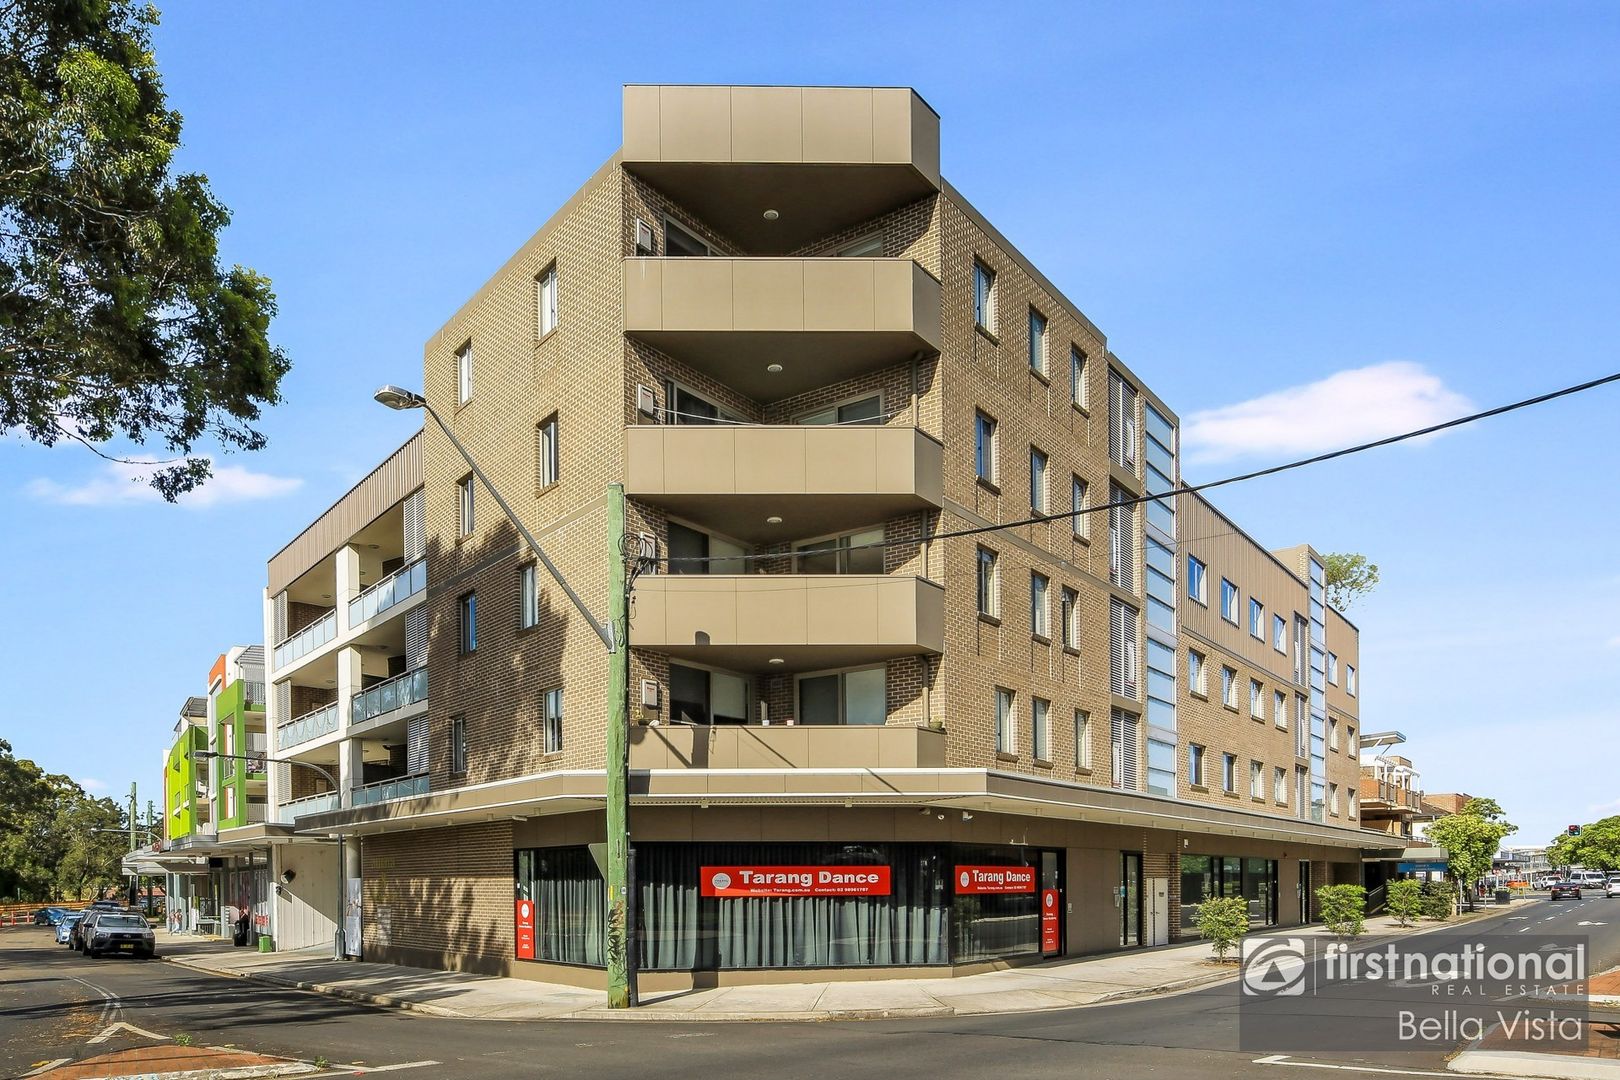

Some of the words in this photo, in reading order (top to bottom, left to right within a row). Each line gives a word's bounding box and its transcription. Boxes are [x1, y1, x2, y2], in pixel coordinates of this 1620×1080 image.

[739, 870, 813, 887] Tarang
[818, 871, 879, 884] Dance
[972, 869, 1004, 885] Tarang
[1006, 870, 1031, 882] Dance
